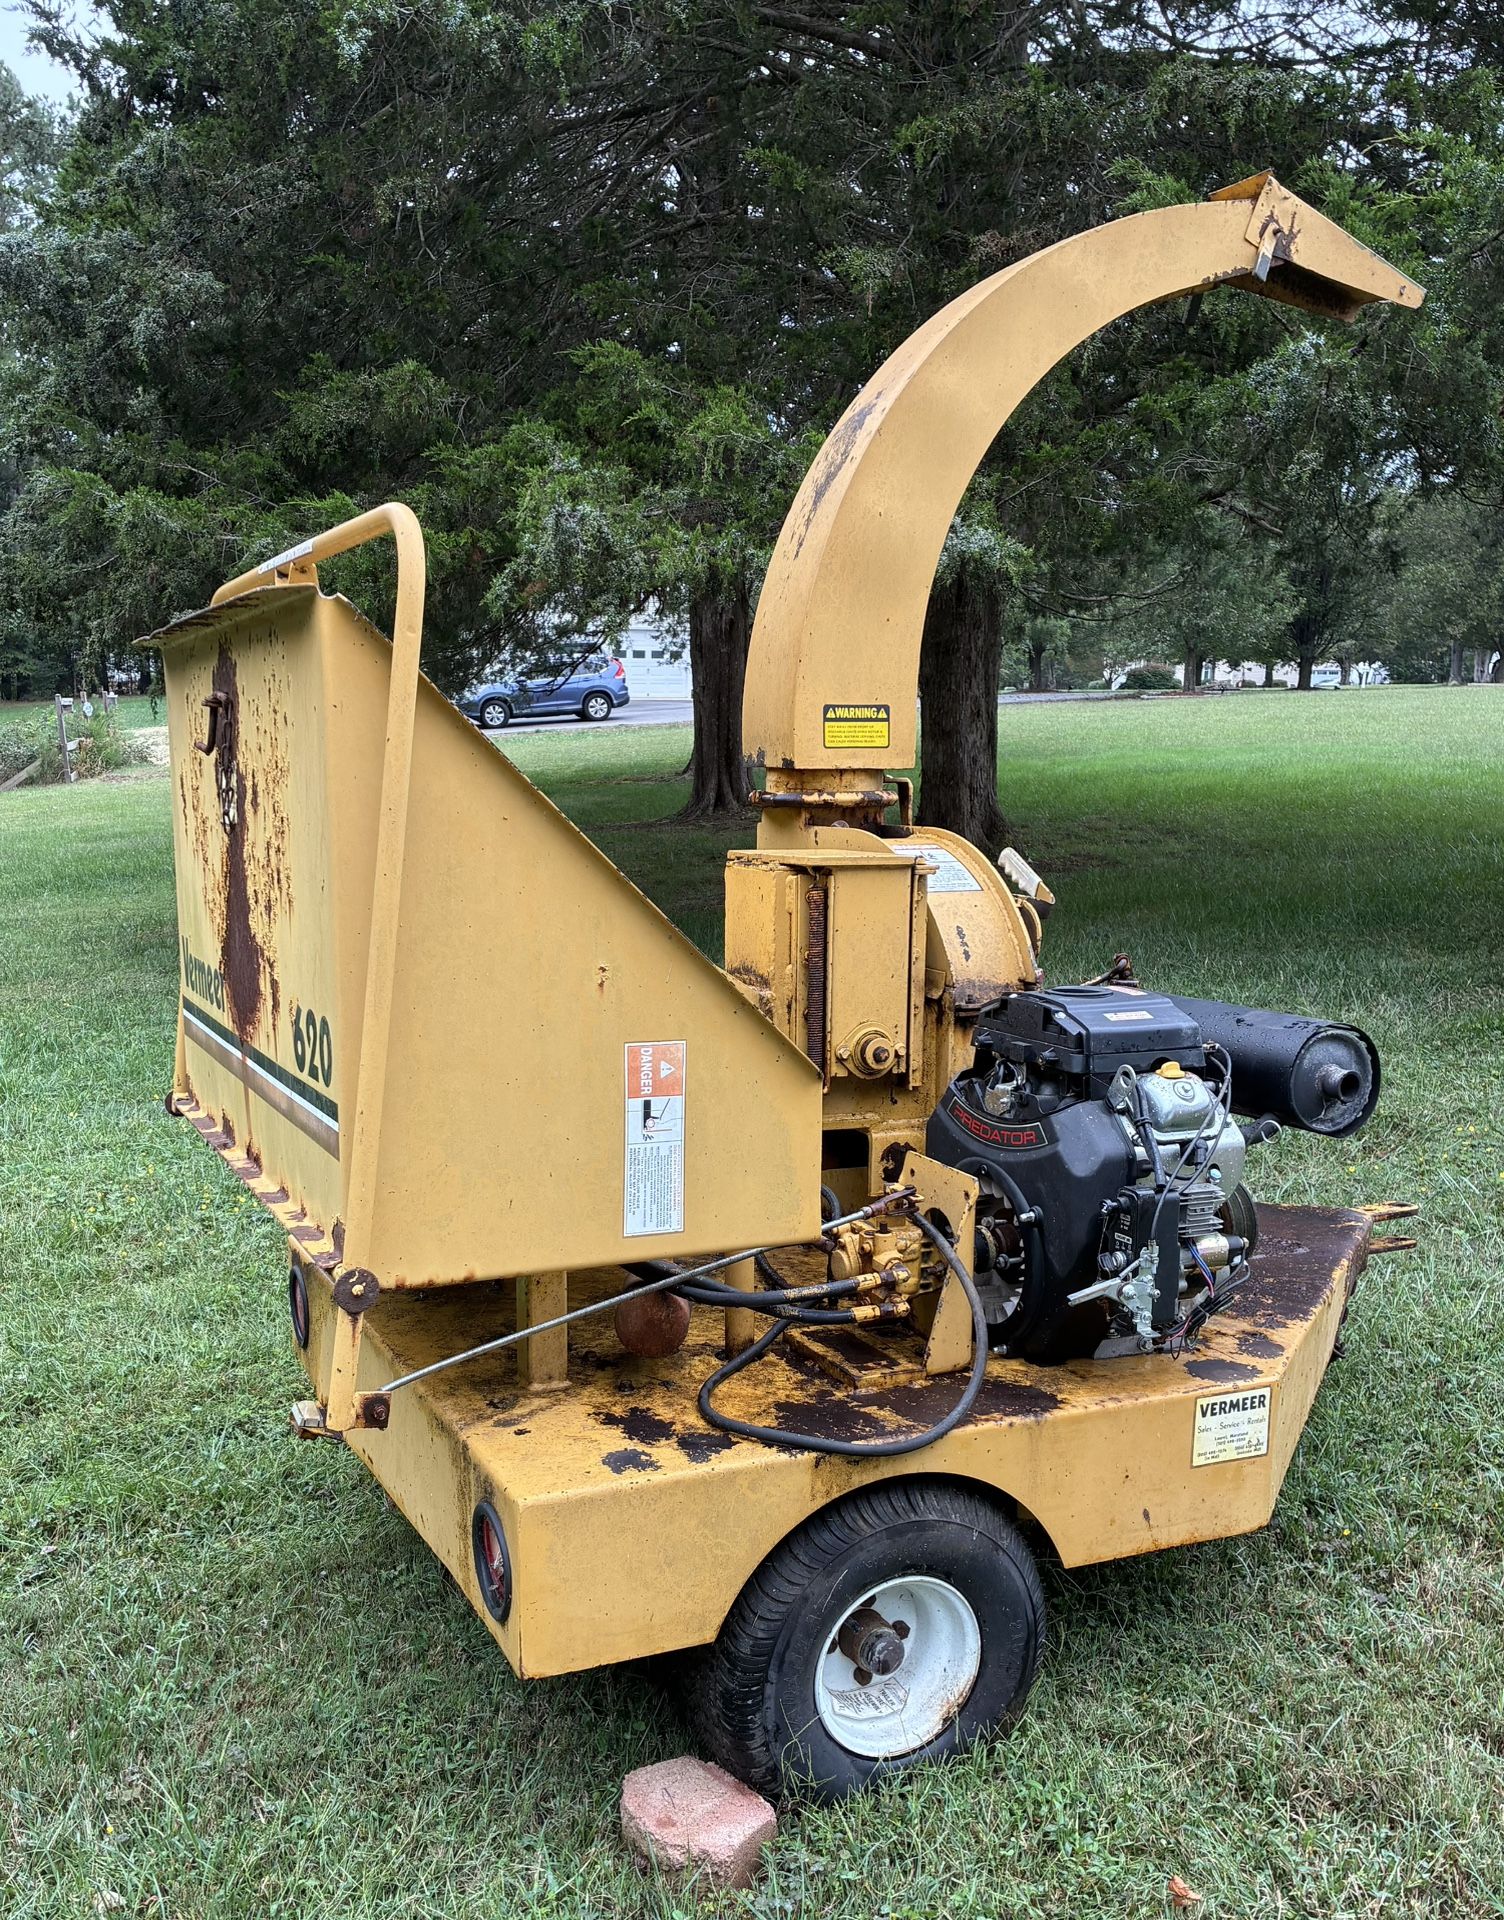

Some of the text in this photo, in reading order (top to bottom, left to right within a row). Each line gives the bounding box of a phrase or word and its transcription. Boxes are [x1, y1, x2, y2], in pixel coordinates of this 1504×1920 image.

[835, 707, 878, 719] WARNING
[181, 934, 226, 1012] Vermeer
[293, 1004, 332, 1088] 620
[640, 1047, 653, 1095] DANGER
[954, 1105, 1037, 1144] PREDATOR
[1198, 1425, 1212, 1434] Sales
[1219, 1420, 1240, 1430] Service
[1247, 1415, 1266, 1426] Rentals
[1200, 1394, 1266, 1418] VERMEER
